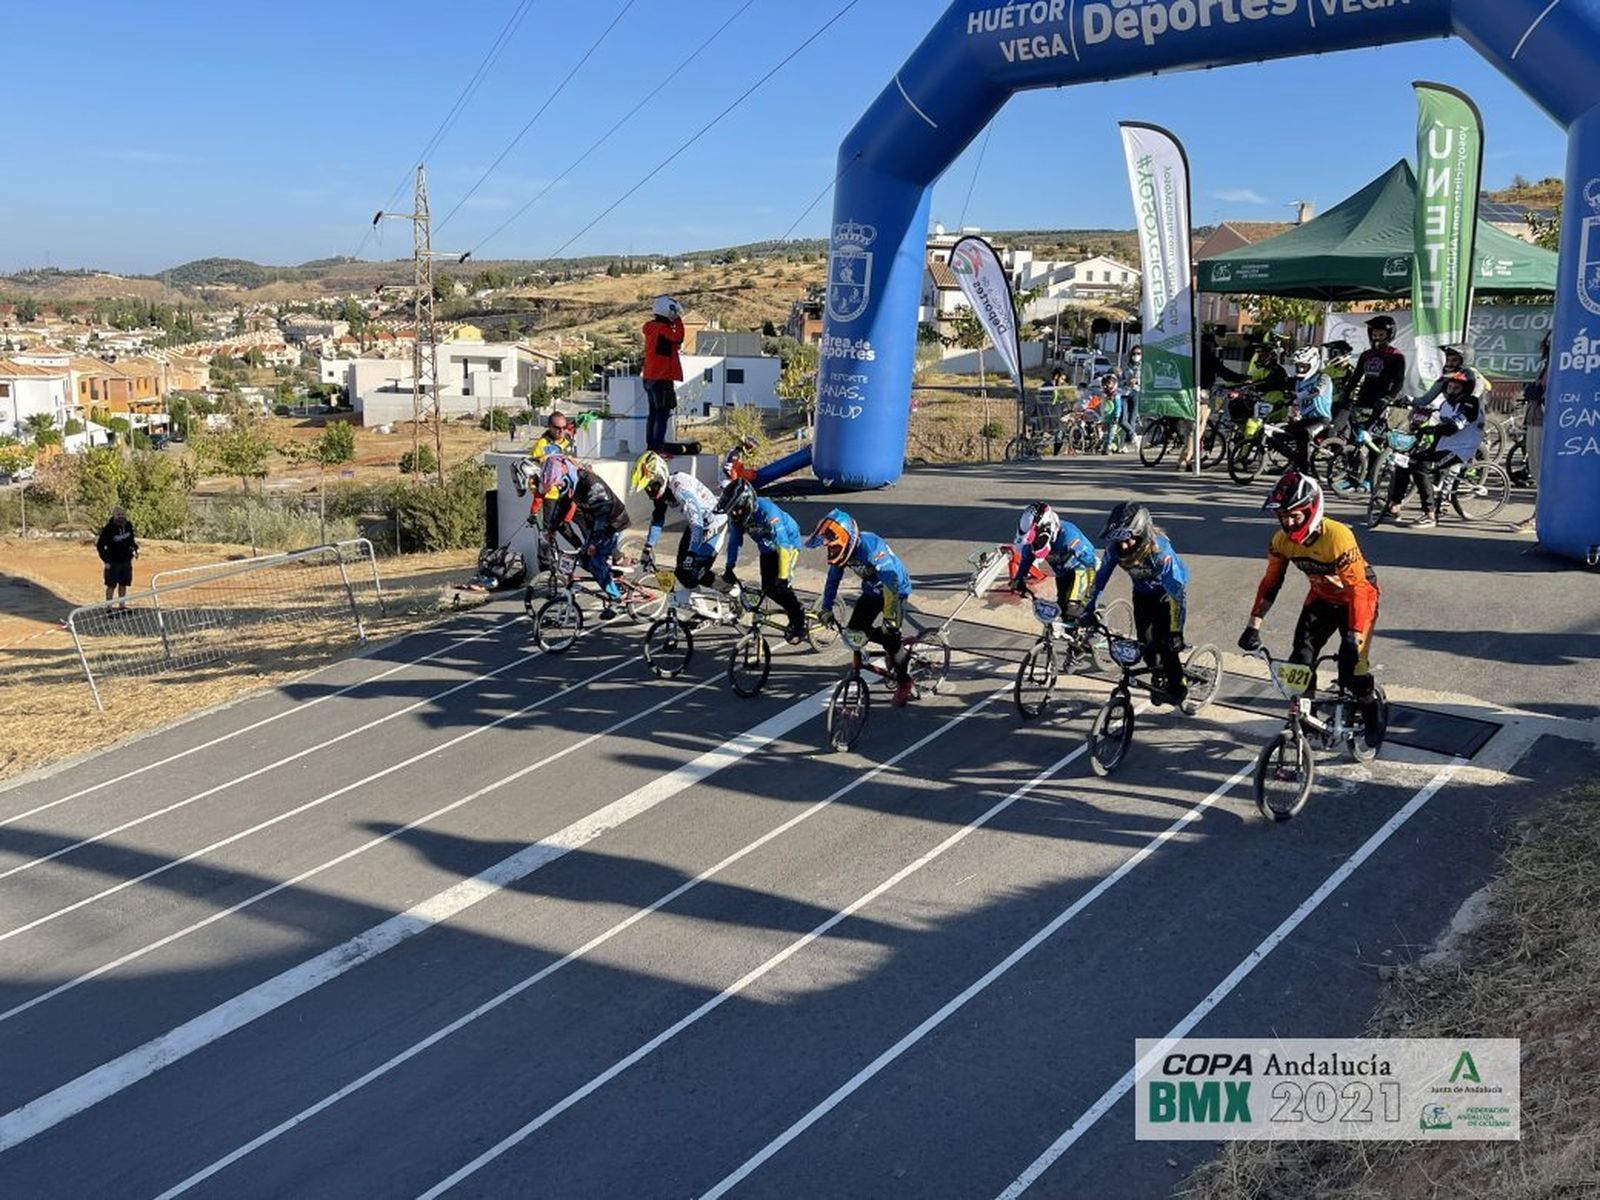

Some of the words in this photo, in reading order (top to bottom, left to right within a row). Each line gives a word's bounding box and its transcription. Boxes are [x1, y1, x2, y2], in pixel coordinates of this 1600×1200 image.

[967, 0, 1065, 34] HUÉTOR
[1000, 33, 1069, 62] VEGA
[823, 346, 876, 361] eportes
[855, 339, 871, 350] de
